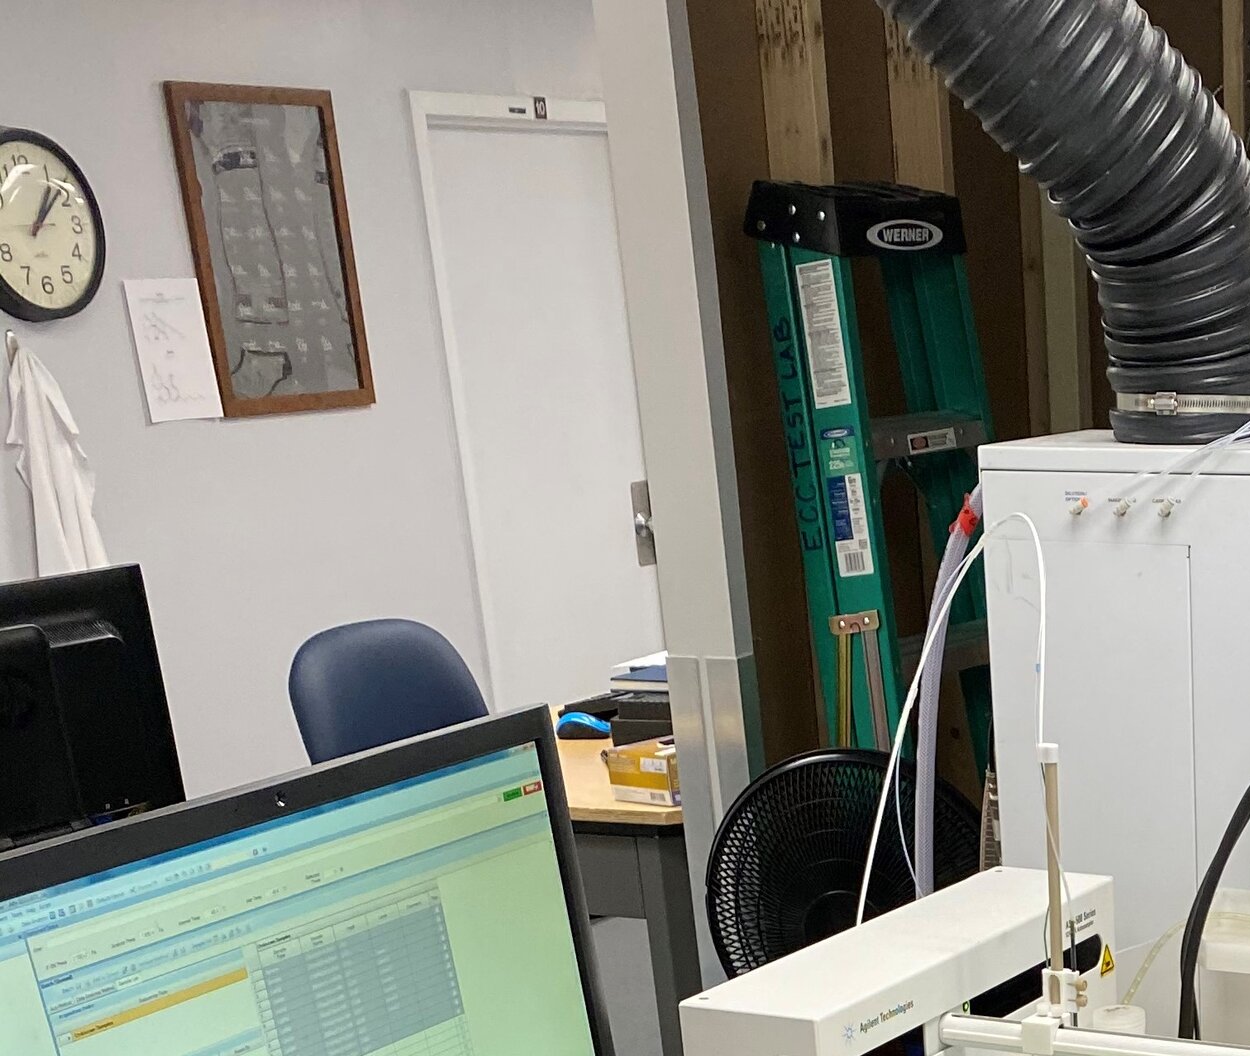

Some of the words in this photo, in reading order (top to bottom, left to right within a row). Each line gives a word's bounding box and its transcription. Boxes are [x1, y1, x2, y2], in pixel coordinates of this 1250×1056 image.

[58, 181, 72, 207] 2
[71, 216, 83, 234] 3
[883, 228, 929, 242] WERNER
[1, 243, 12, 262] 8
[71, 243, 81, 261] 4
[20, 266, 31, 285] 7
[60, 265, 73, 284] 5
[41, 276, 54, 294] 6
[773, 316, 797, 381] LAB
[786, 398, 810, 478] TEST
[796, 484, 823, 551] ECC
[860, 1016, 879, 1033] Agilent
[880, 1000, 914, 1022] Technologies
